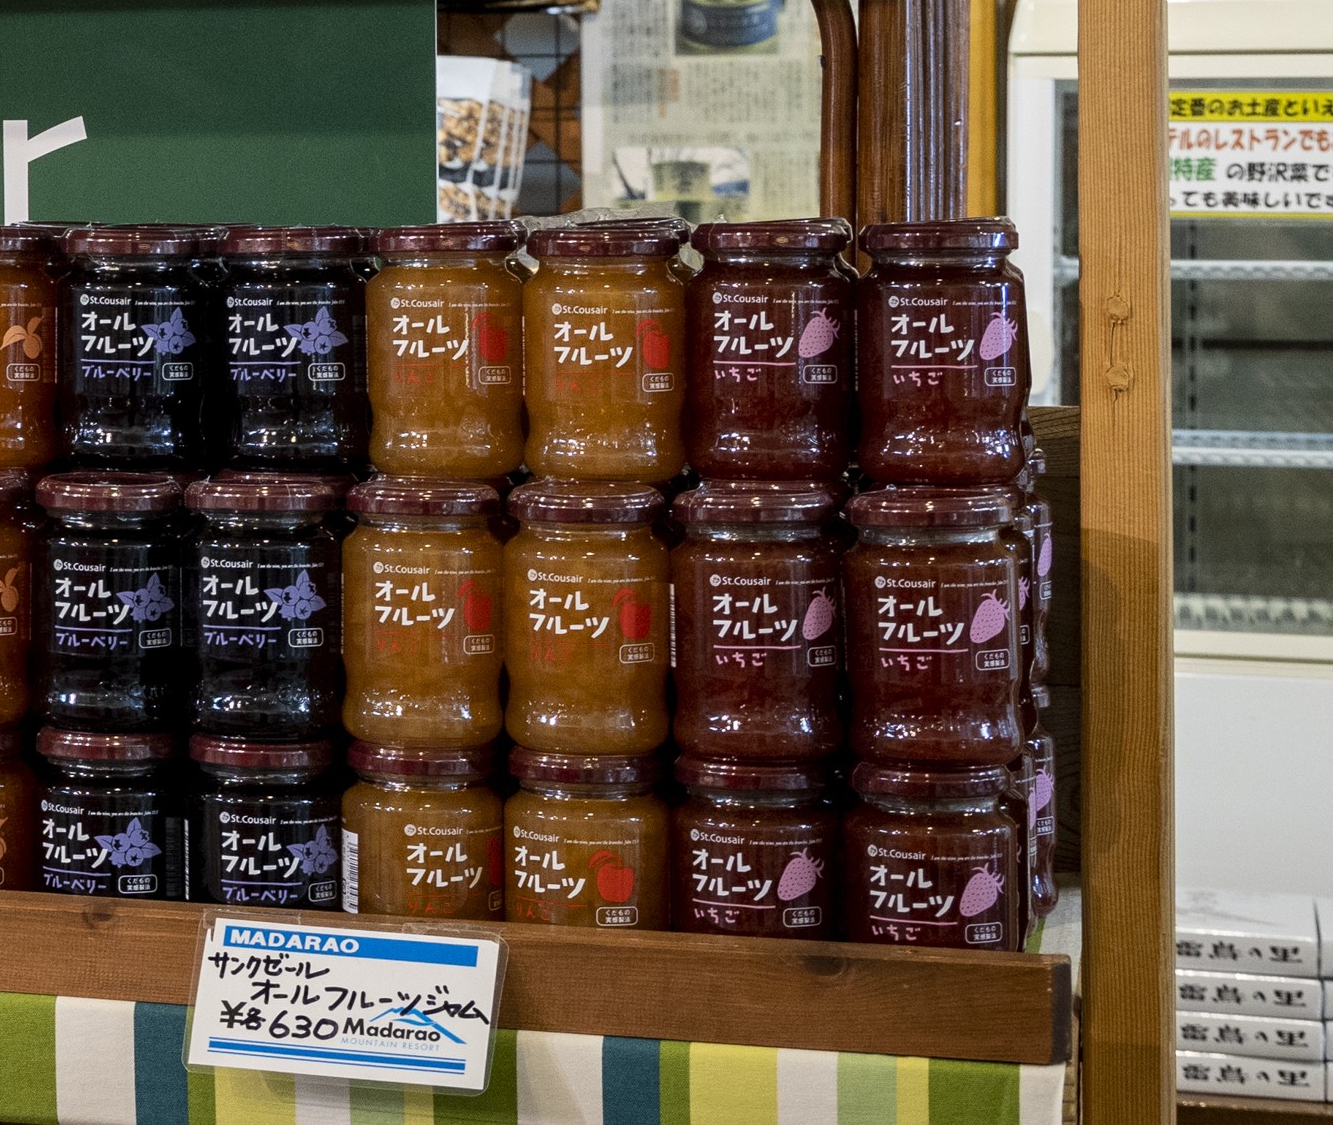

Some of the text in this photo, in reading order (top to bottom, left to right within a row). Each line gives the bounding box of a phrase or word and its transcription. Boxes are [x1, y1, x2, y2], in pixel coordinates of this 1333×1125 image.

[1169, 157, 1216, 181] 特産
[90, 296, 131, 306] St.Cousair
[900, 297, 948, 307] St.Cousair
[81, 311, 136, 331] オール
[393, 314, 451, 335] オール
[891, 313, 955, 335] オール
[81, 335, 154, 357] フルーツ
[393, 339, 469, 361] フルーツ
[891, 338, 975, 362] フルーツ
[82, 365, 152, 382] ブルーベリー
[894, 371, 944, 387] いちご
[869, 864, 933, 889] オール
[869, 890, 955, 917] フルーツ
[230, 929, 360, 954] MADARAO
[208, 952, 331, 979] サンクゼール
[250, 979, 490, 1025] オールフルーツジャム
[343, 1017, 442, 1042] Madarao
[340, 1037, 440, 1053] MOUNTAIN RESORT
